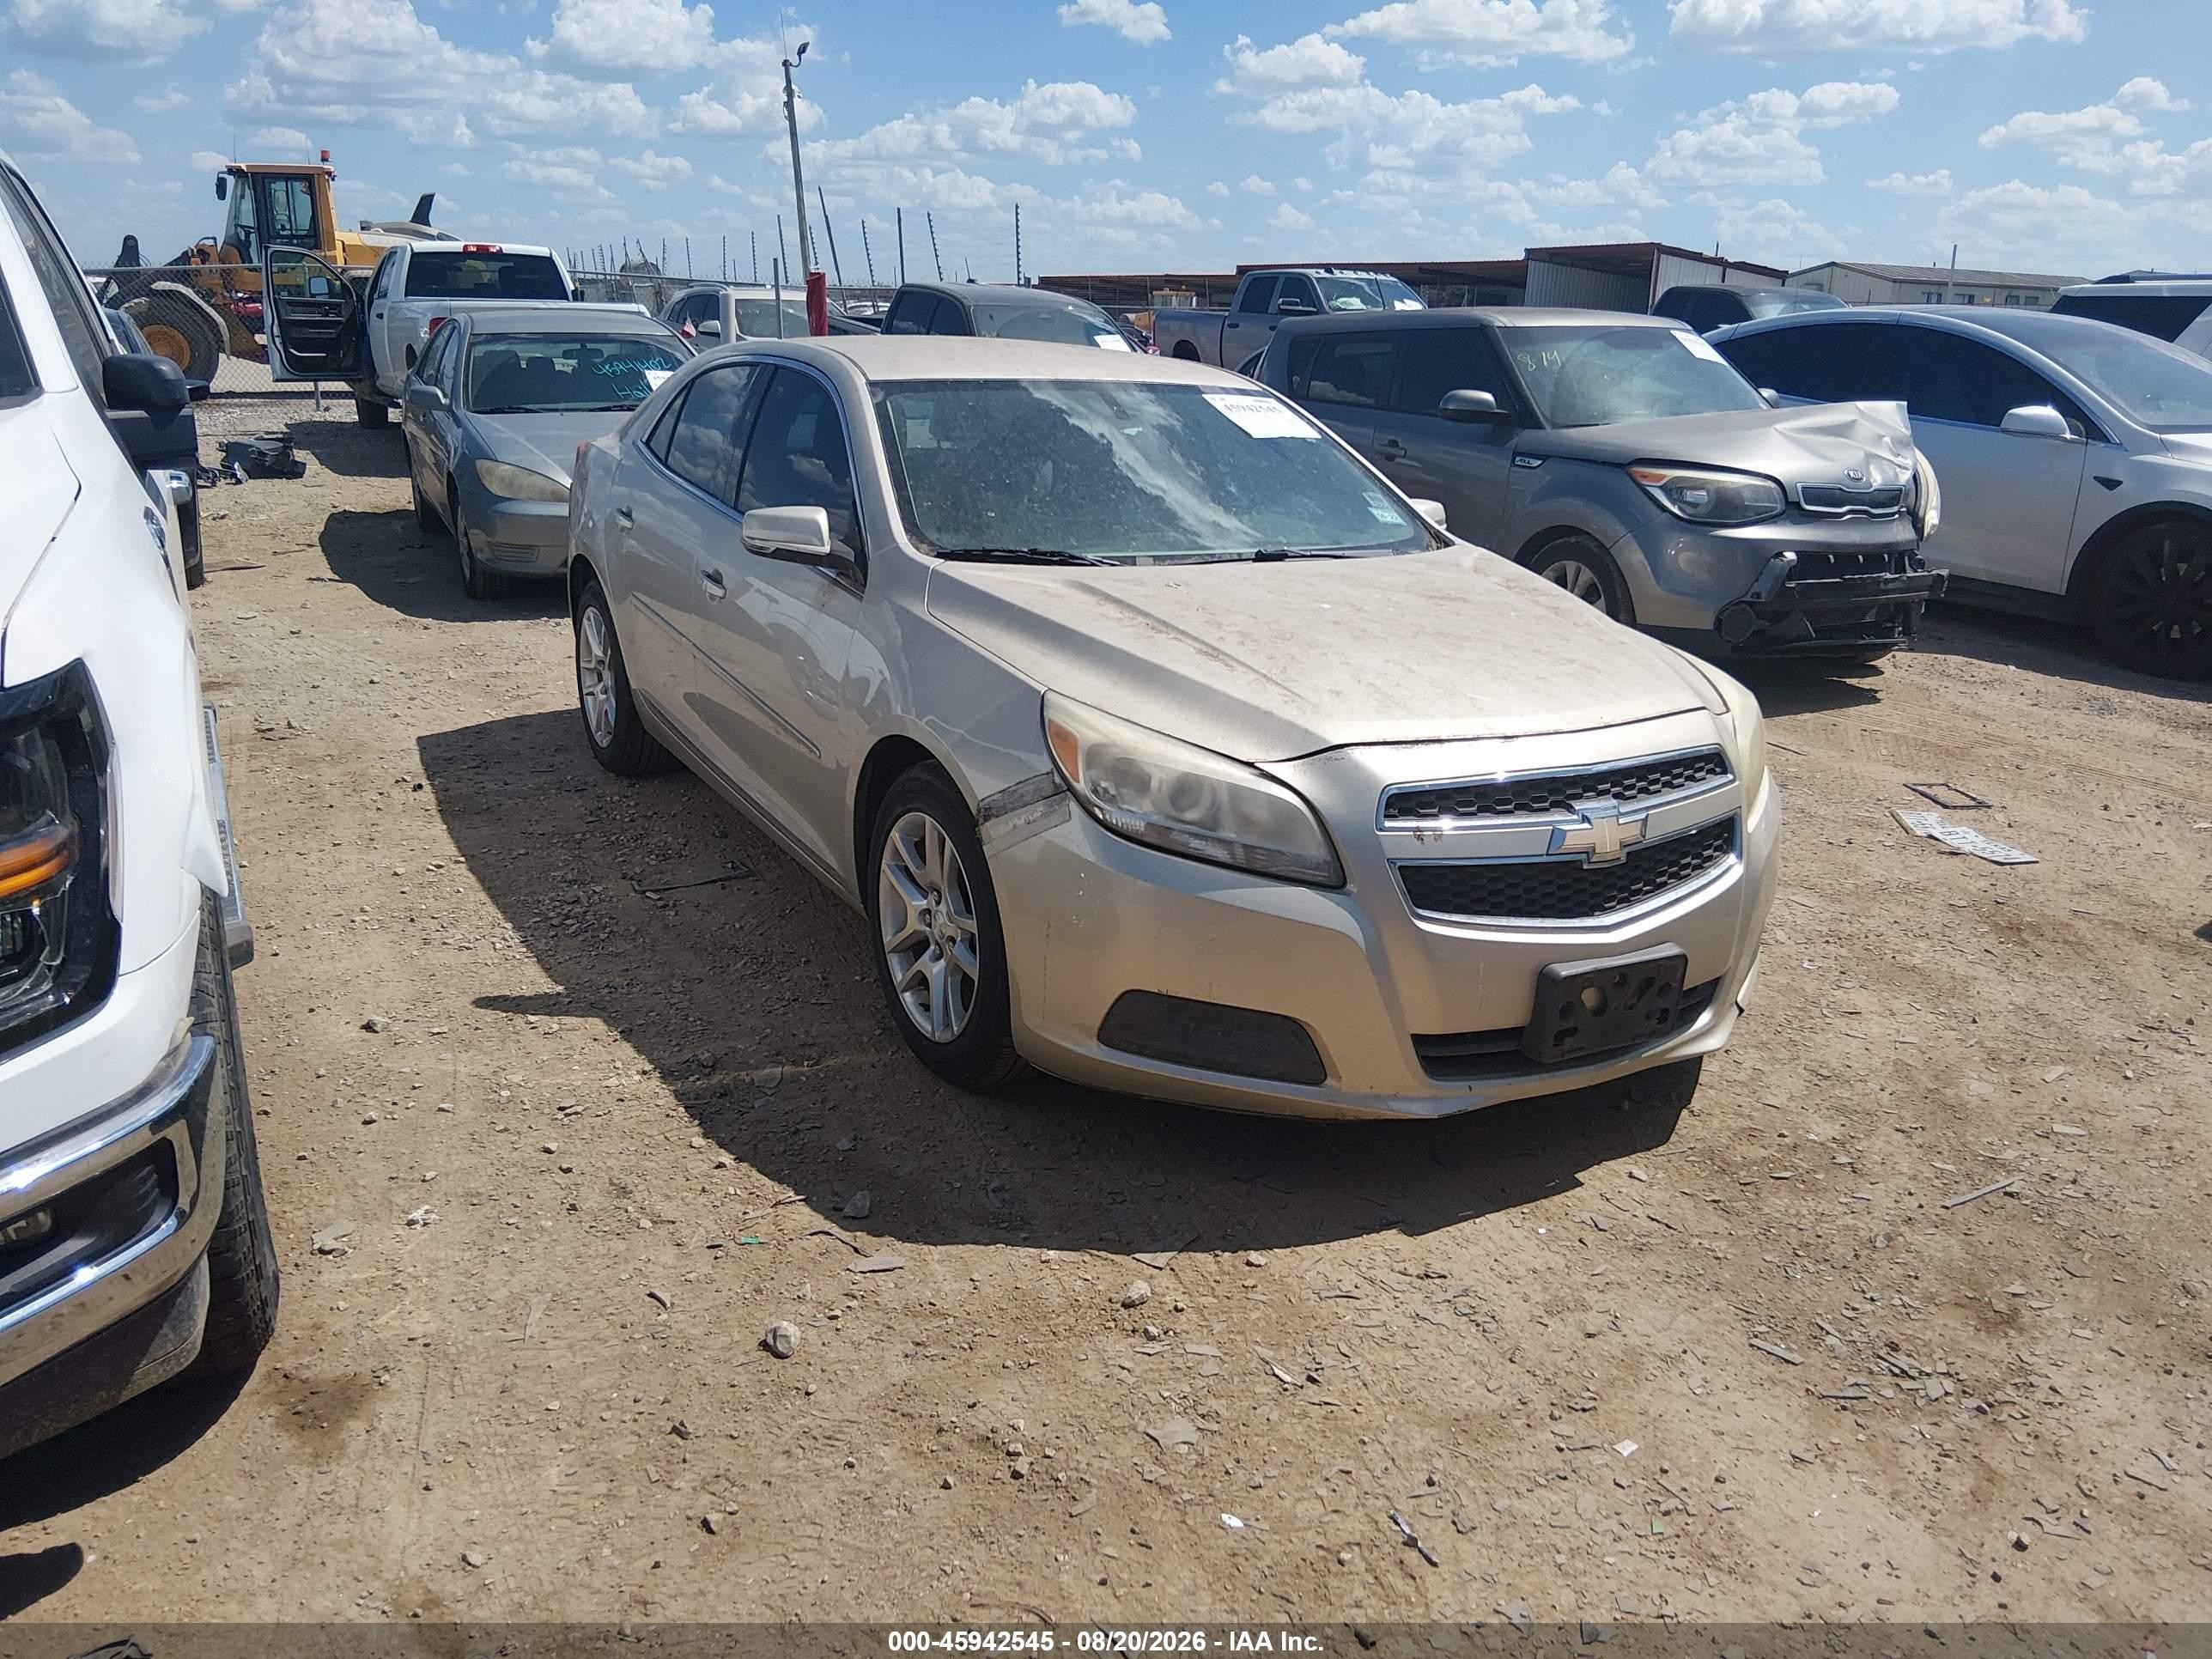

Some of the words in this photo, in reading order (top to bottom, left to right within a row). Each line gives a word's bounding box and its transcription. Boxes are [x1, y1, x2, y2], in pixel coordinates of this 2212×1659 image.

[591, 357, 672, 377] 45941402
[1516, 350, 1561, 371] 8-14
[611, 379, 653, 398] Hail
